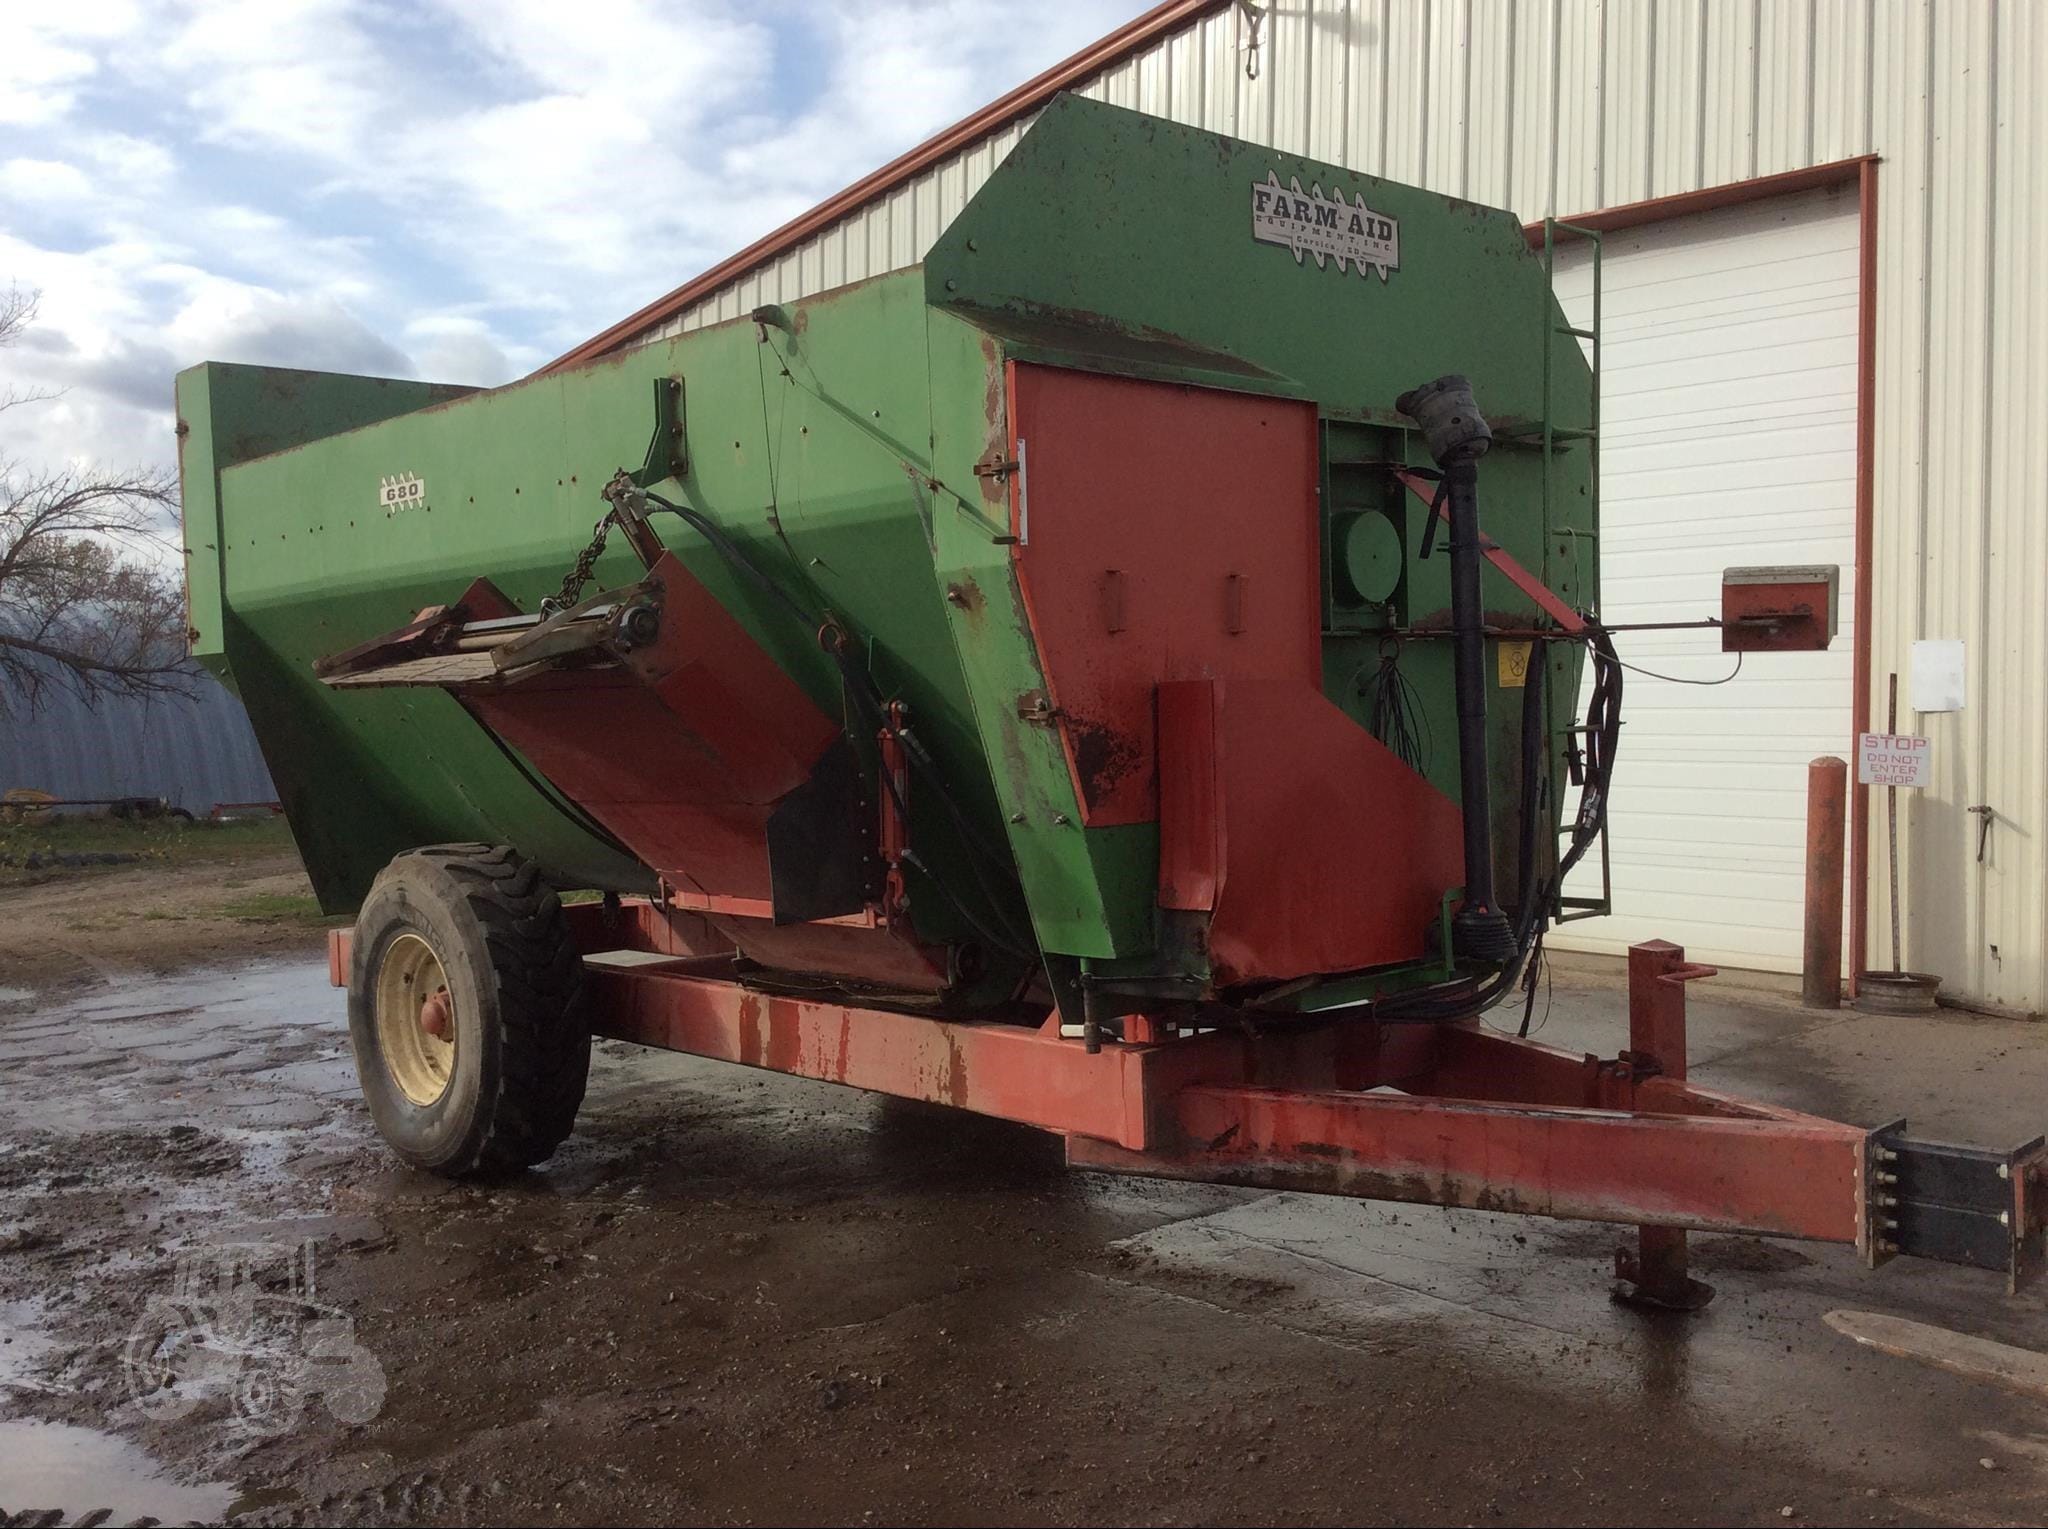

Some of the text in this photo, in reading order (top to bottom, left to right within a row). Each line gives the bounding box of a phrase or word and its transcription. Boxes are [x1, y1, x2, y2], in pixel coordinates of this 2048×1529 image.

[1255, 191, 1392, 242] FARM AID
[1364, 239, 1392, 252] INC.
[387, 483, 418, 501] 680
[1865, 735, 1927, 751] STOP
[1867, 753, 1922, 765] DO NOT
[1870, 763, 1917, 775] ENTER
[1874, 774, 1914, 784] SHOP
